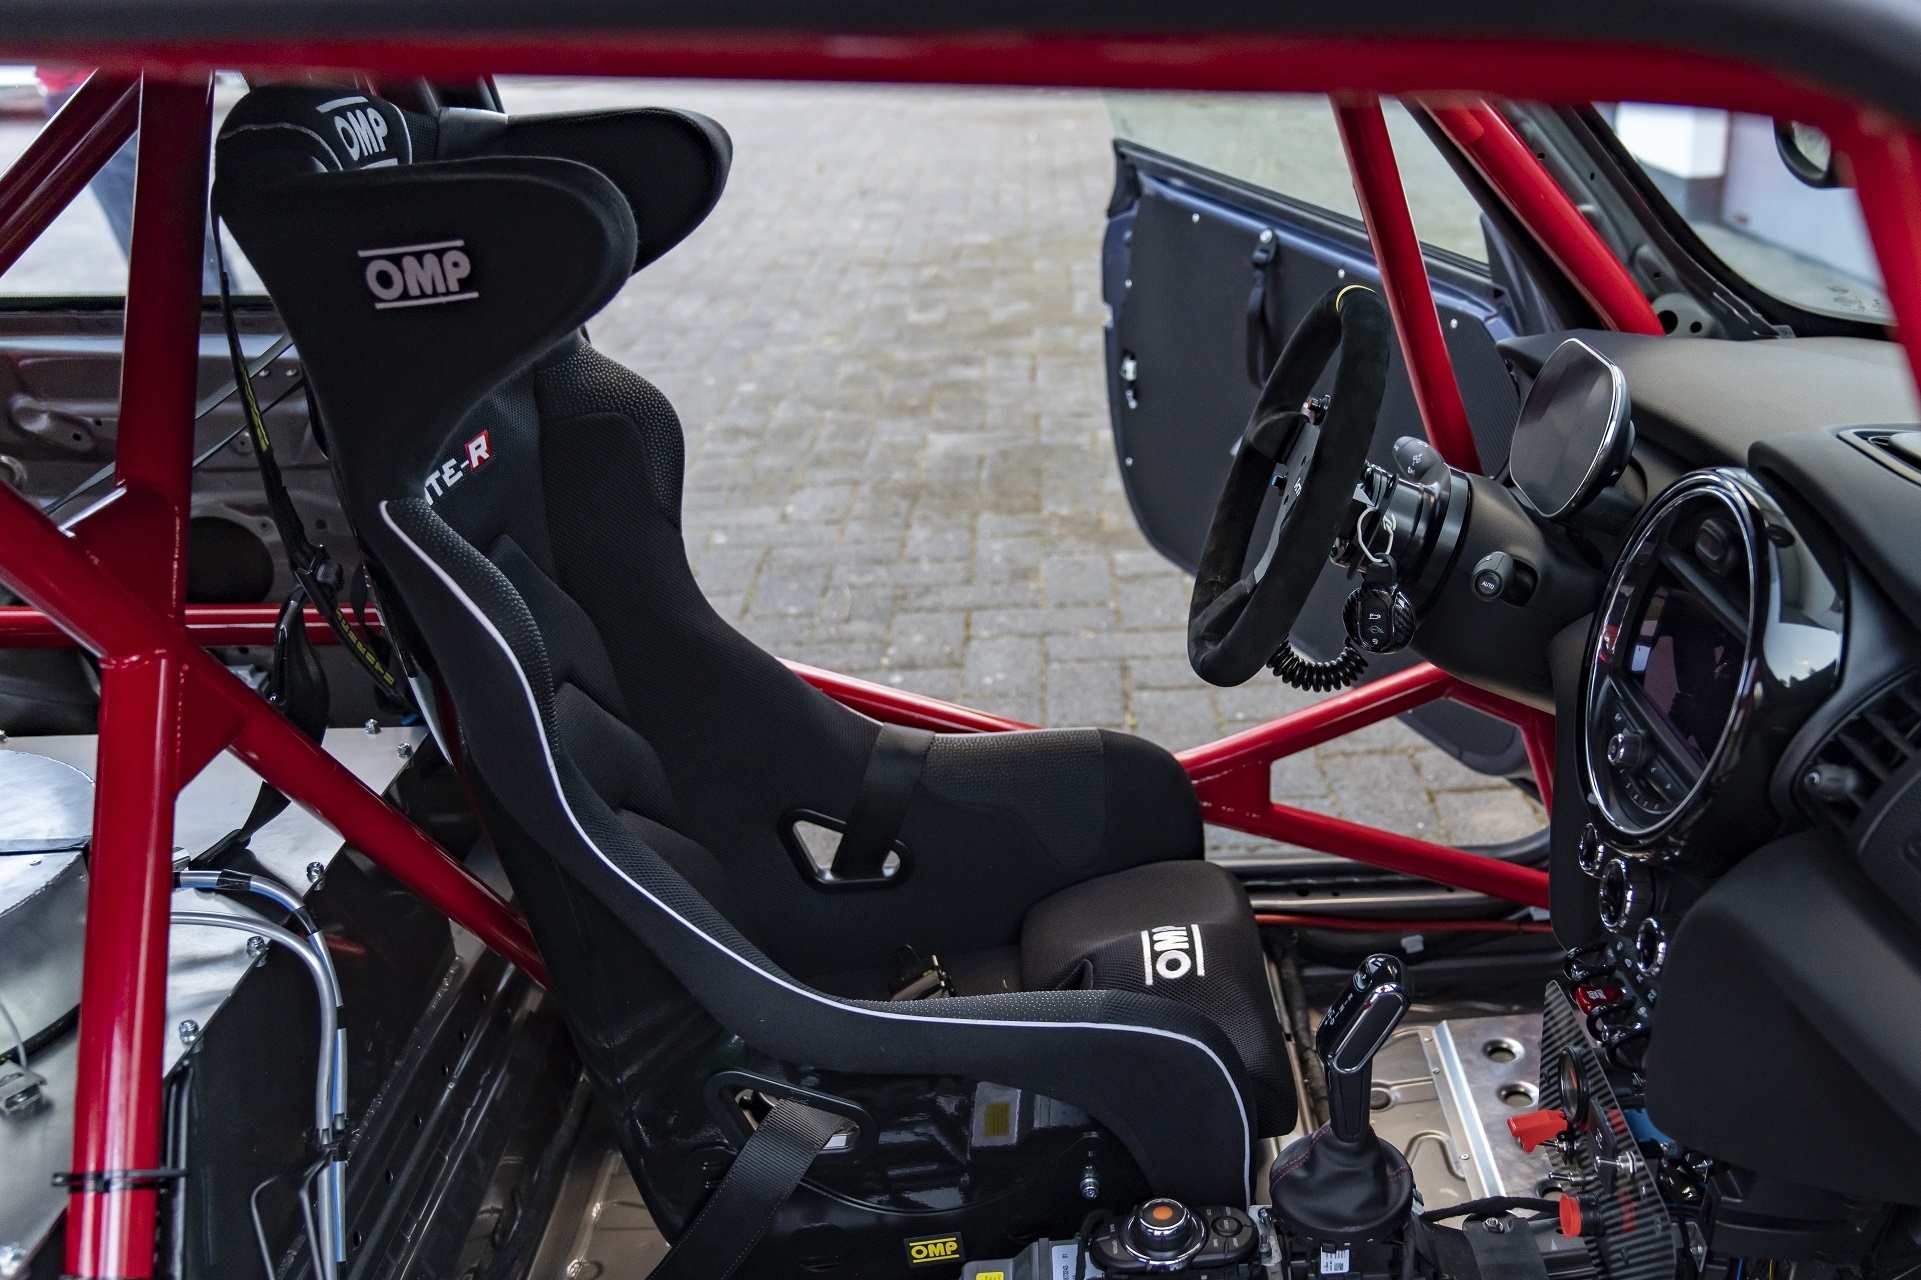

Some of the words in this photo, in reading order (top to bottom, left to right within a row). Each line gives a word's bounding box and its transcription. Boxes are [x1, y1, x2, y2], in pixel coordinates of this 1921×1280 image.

[334, 107, 388, 161] OMP
[365, 249, 471, 301] OMP
[1481, 580, 1495, 590] AUTO
[911, 1241, 958, 1259] OMP
